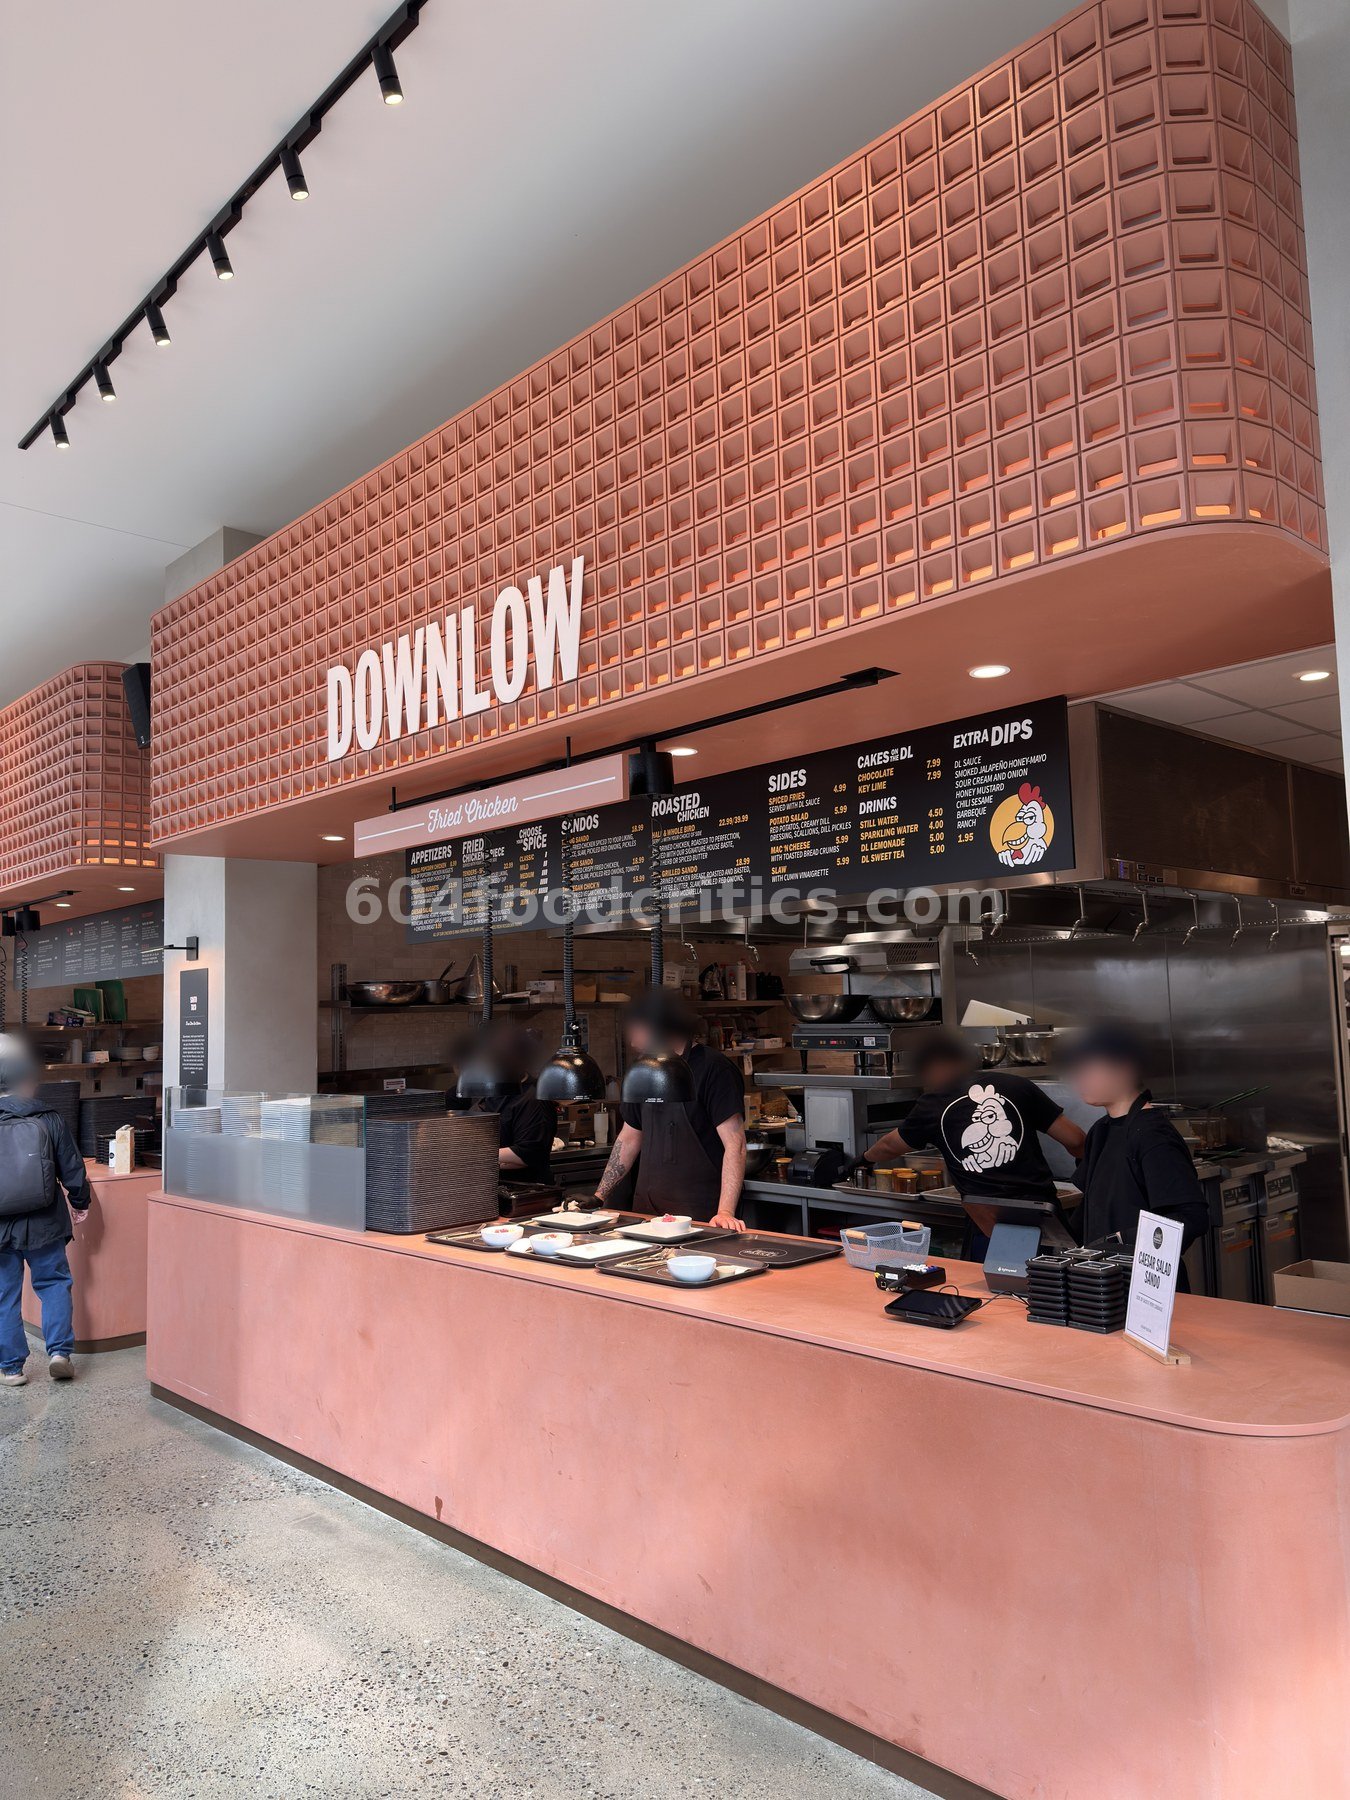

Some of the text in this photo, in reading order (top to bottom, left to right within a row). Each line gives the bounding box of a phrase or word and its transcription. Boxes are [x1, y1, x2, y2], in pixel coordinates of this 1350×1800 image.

[328, 555, 584, 762] DOWNLOW
[953, 718, 1032, 748] EXTRA DIPS
[858, 751, 889, 769] CAKES
[900, 746, 913, 760] DL
[954, 756, 981, 768] DL SAUCE
[858, 758, 940, 782] CHOCOLATE 7.99
[955, 767, 978, 778] SMOKED
[955, 768, 1028, 788] SOUR CREAM AND ONION
[768, 769, 806, 792] SIDES
[858, 770, 941, 794] KEY LIME 7.99
[769, 784, 846, 805] SPICED FRIES 4.99
[956, 783, 1004, 798] HONEY MUSTARD
[652, 792, 710, 823] ROASTED CHICKEN
[769, 805, 785, 813] SERVED
[805, 797, 820, 807] SAUCE
[859, 796, 896, 815] DRINKS
[956, 795, 993, 808] CHILI SESAME
[428, 796, 518, 833] Fried Chicken
[770, 805, 847, 826] POTATO SALAD 5.99
[860, 808, 943, 829] STILL WATER 4.50
[957, 807, 987, 819] BARBEQUE
[519, 825, 542, 838] CHOOSE
[684, 825, 695, 833] BIRD
[800, 819, 819, 829] CREAMY
[832, 822, 851, 832] PICKLES
[860, 820, 944, 840] SPARKLING WATER 4.00
[957, 819, 976, 829] RANCH
[462, 838, 484, 854] FRIED
[522, 834, 547, 852] SPICE
[770, 846, 783, 854] MAC
[789, 841, 810, 851] CHEESE
[836, 835, 848, 845] 5.99
[861, 832, 944, 852] DL LEMONADE 5.00
[958, 833, 974, 843] 1.95
[411, 845, 452, 865] APPETIZERS
[462, 852, 484, 863] CHICKEN
[771, 846, 840, 862] WITH TOASTED BREAD CRUMBS
[861, 844, 945, 864] DL SWEET TEA 5.00
[682, 866, 698, 875] SANDO
[736, 857, 750, 867] 18.99
[771, 857, 849, 875] SLAW 5.99
[1138, 1251, 1172, 1277] CAESAR SALAD
[1144, 1270, 1161, 1289] SANDO
